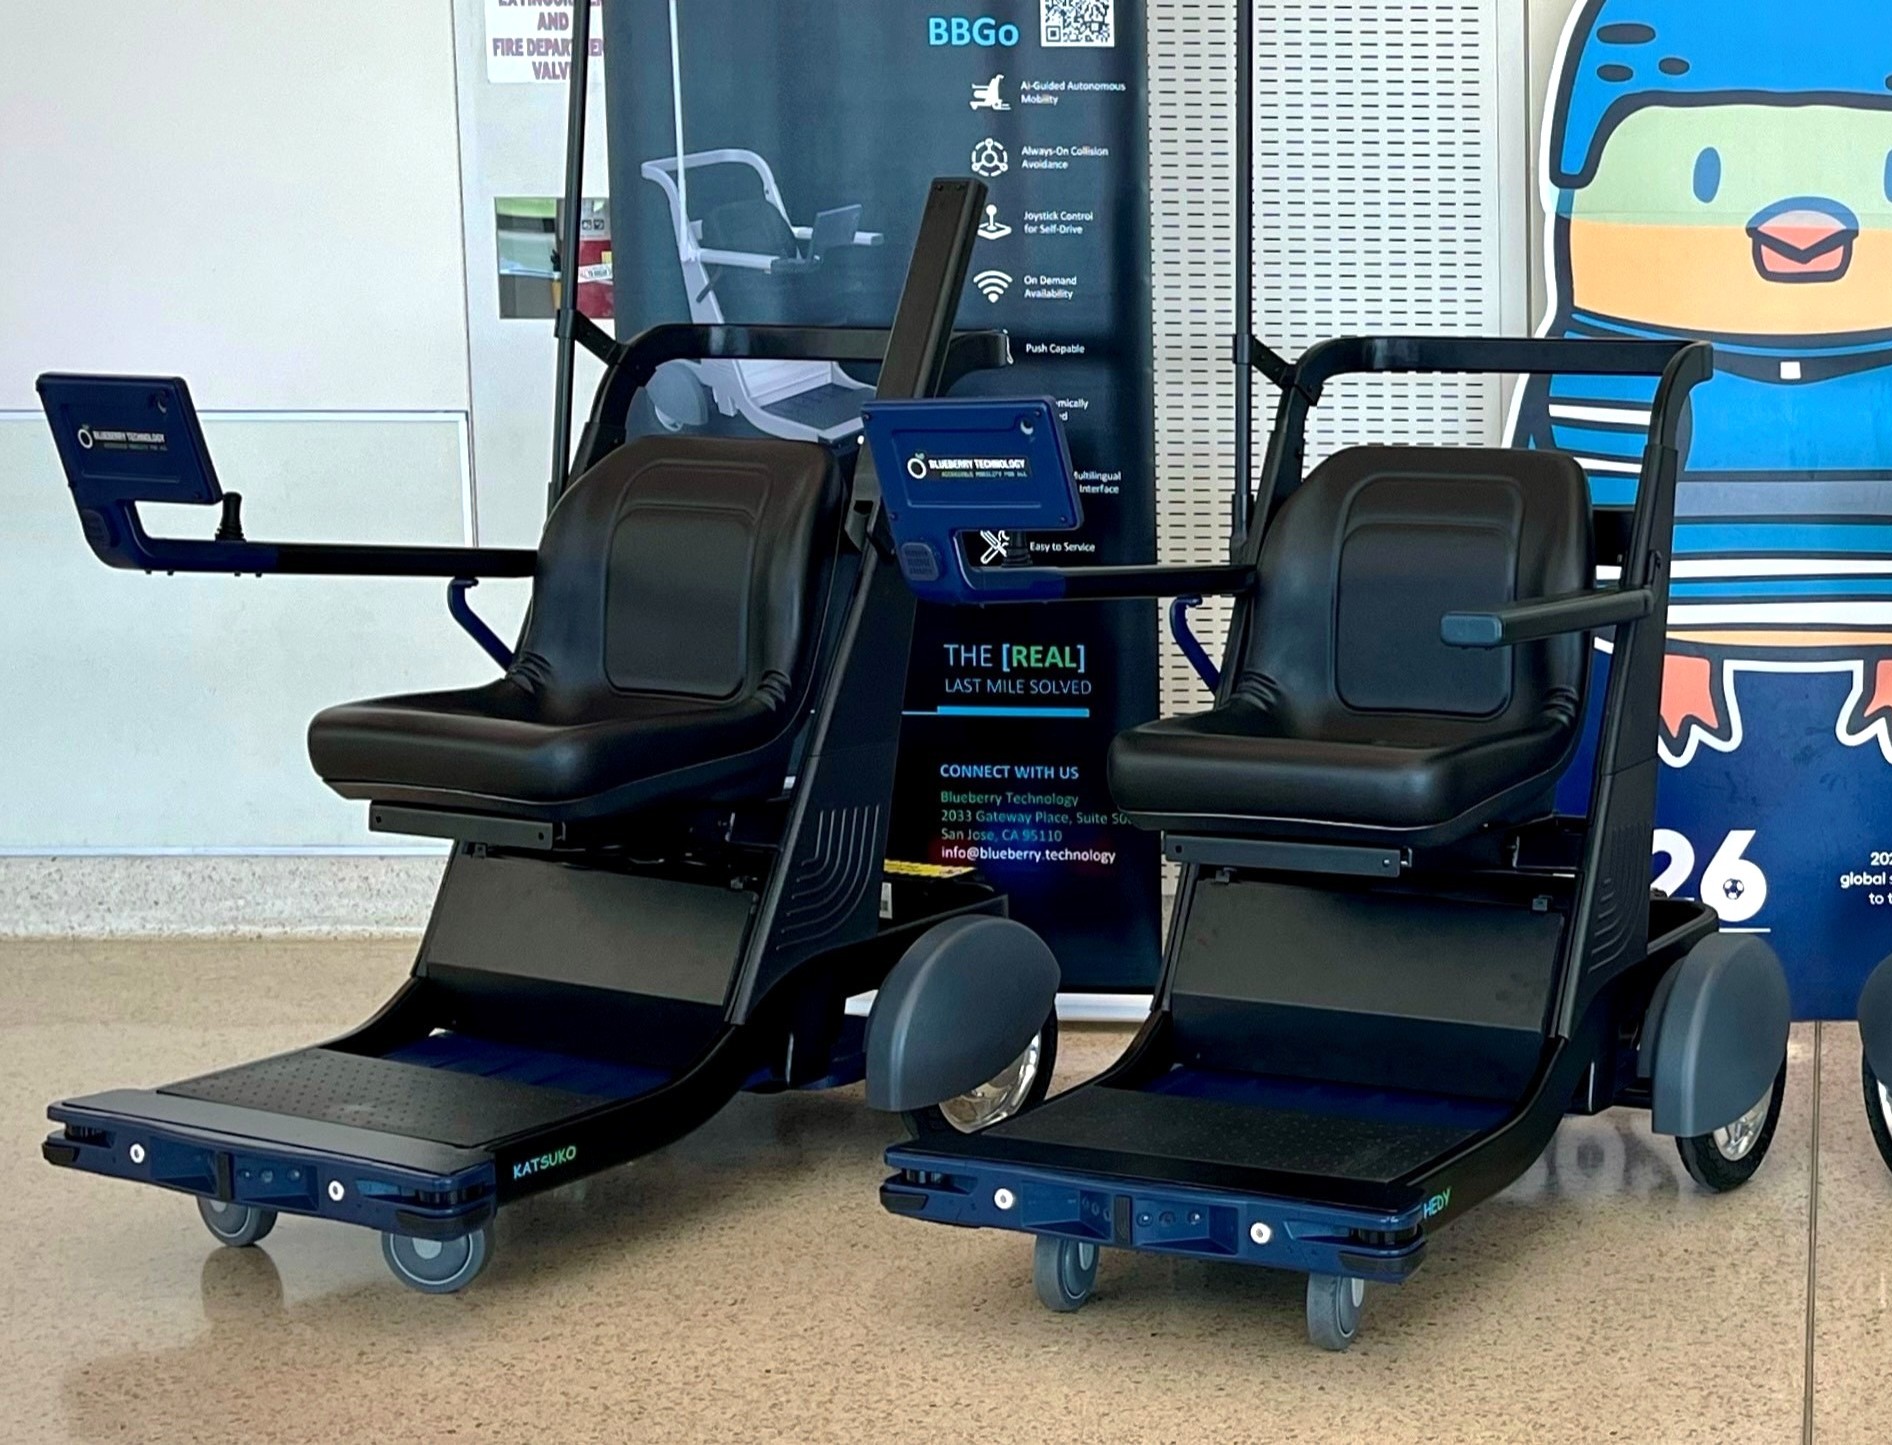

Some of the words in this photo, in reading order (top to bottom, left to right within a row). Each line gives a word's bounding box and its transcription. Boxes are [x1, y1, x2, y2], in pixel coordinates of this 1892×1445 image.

[537, 12, 569, 30] AND
[929, 17, 1019, 46] BBGo
[492, 38, 524, 56] FIRE
[526, 38, 603, 56] DEPARE
[532, 61, 571, 80] VALV
[1067, 81, 1126, 91] Autonomous
[1021, 94, 1058, 106] Mobility
[1021, 146, 1069, 157] Always-On
[1070, 146, 1109, 156] Collision
[1021, 159, 1068, 170] Avoidance
[1024, 211, 1058, 222] Joystick
[1060, 211, 1094, 221] Control
[1024, 223, 1037, 233] for
[1040, 224, 1083, 234] Self-Drive
[1023, 275, 1038, 285] On
[1040, 275, 1077, 286] Demand
[1024, 288, 1073, 300] Availability
[1026, 343, 1047, 353] Push
[1049, 343, 1085, 355] Capable
[928, 459, 973, 469] BLUEBERRY
[974, 459, 1025, 469] TECHNOLOGY
[1079, 484, 1119, 494] Interface
[1029, 541, 1050, 553] Easy
[1052, 542, 1062, 552] to
[1063, 542, 1096, 552] Service
[943, 644, 993, 667] THE
[1002, 643, 1085, 673] [REAL]
[945, 678, 981, 693] LAST
[986, 679, 1025, 694] MILE
[1029, 680, 1092, 695] SOLVED
[940, 764, 1010, 779] CONNECT
[1014, 766, 1055, 779] WITH
[1059, 766, 1079, 780] US
[940, 791, 1002, 806] Blueberry
[1005, 792, 1079, 807] Technology
[941, 810, 972, 822] 2033
[975, 810, 1032, 825] Gateway
[1035, 811, 1073, 825] Place,
[1076, 812, 1108, 824] Suite
[941, 828, 964, 841] San
[967, 829, 999, 843] Jose,
[1002, 829, 1019, 842] CA
[1022, 829, 1063, 842] 95110
[941, 846, 1116, 864] info@blueberry.technology
[1840, 872, 1886, 888] global
[1868, 892, 1884, 905] to
[513, 1145, 577, 1180] KATSUKO
[1423, 1187, 1451, 1219] HEDY
